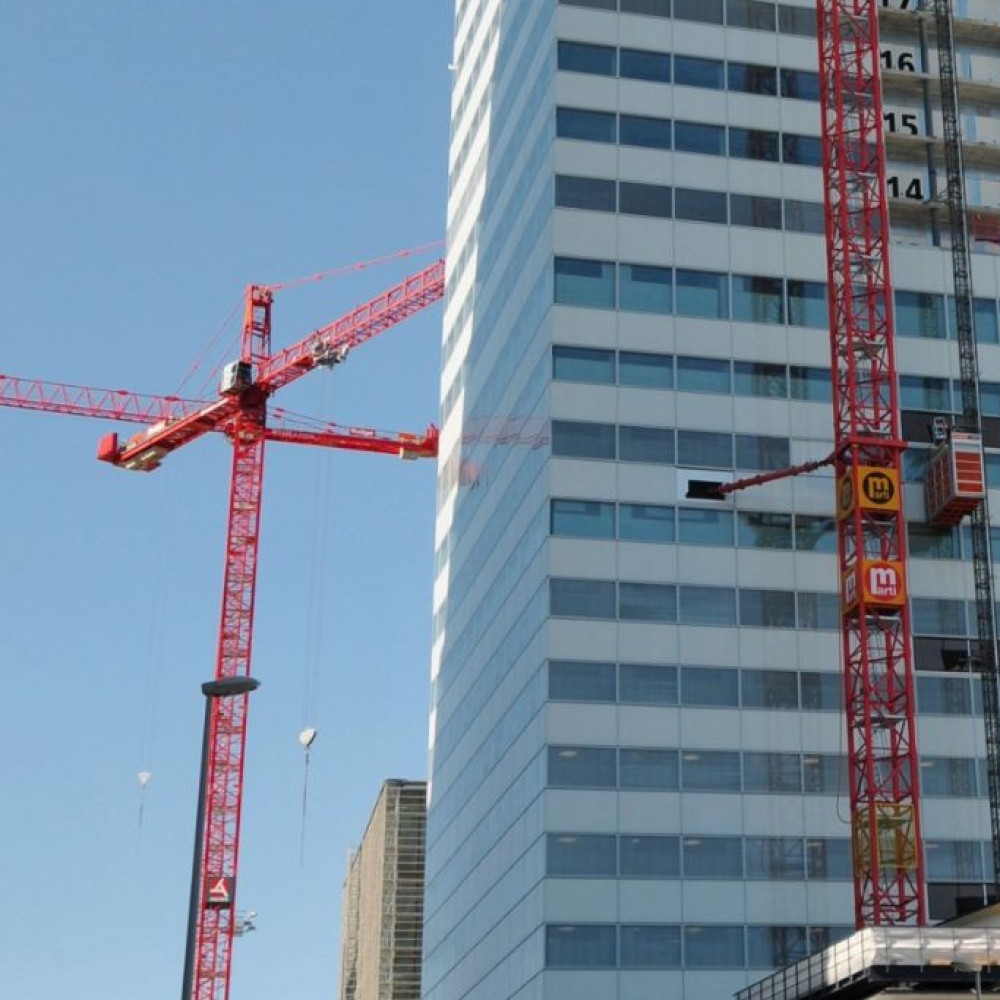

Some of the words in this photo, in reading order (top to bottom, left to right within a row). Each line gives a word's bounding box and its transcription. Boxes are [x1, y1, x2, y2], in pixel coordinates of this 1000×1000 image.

[880, 50, 914, 72] 16
[883, 113, 919, 135] 15
[886, 177, 924, 199] 14
